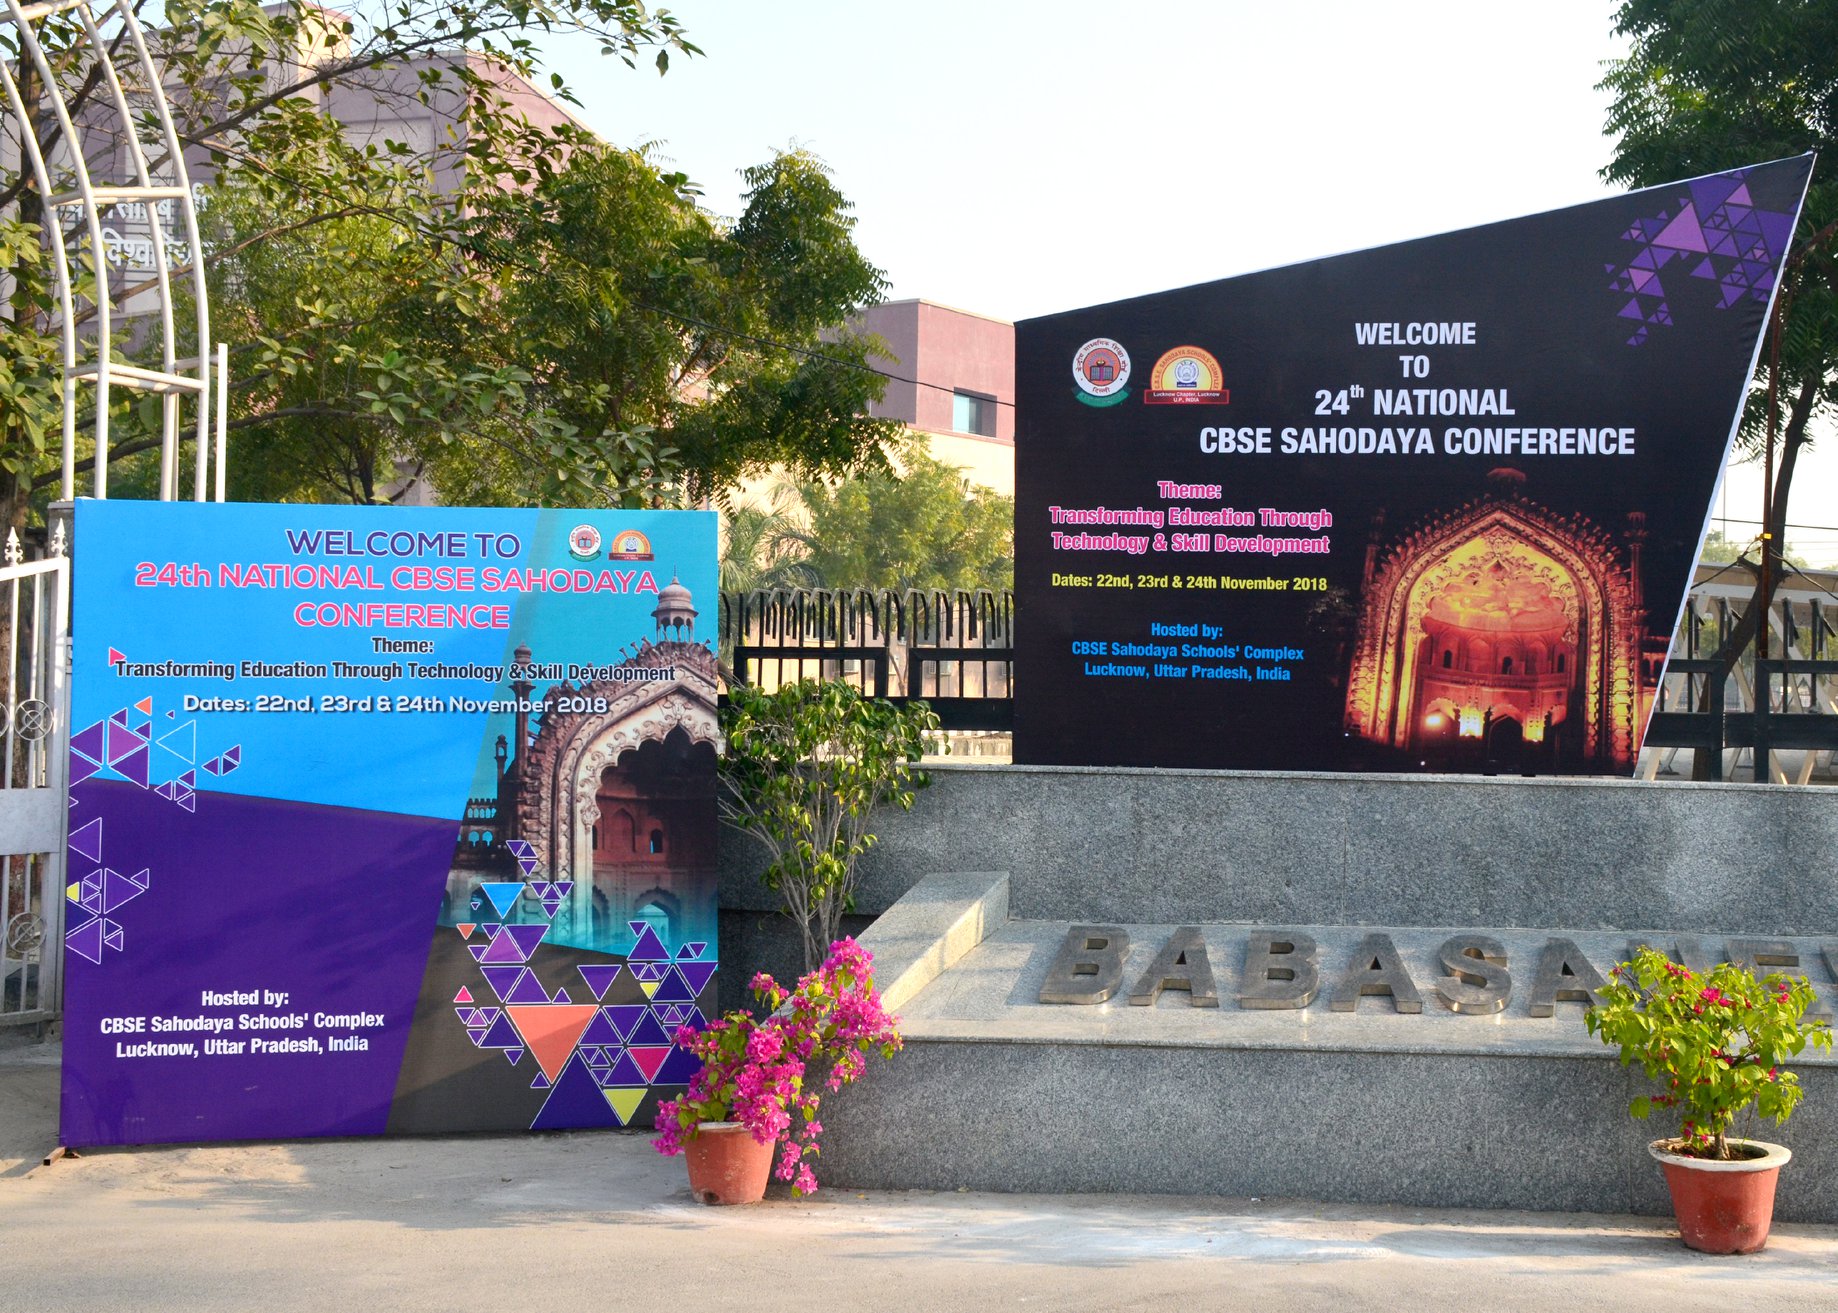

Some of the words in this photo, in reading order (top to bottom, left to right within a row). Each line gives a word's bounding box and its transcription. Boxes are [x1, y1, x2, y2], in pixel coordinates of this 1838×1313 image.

[1355, 322, 1477, 345] WELCOME
[1399, 355, 1430, 378] TO
[1314, 385, 1365, 416] 24th
[1373, 388, 1515, 416] NATIONAL
[1199, 427, 1272, 454] CBSE
[1281, 427, 1435, 455] SAHODAYA
[1444, 427, 1636, 456] CONFERENCE
[1157, 481, 1222, 499] Theme:
[1049, 506, 1164, 528] Transforming
[1169, 508, 1255, 526] Education
[1259, 509, 1333, 530] Through
[286, 529, 467, 557] WELCOME
[474, 533, 521, 559] TO
[1051, 532, 1149, 554] Technology
[1153, 534, 1167, 551] &
[1171, 533, 1210, 552] Skill
[1215, 534, 1330, 556] Development
[135, 562, 211, 588] 24th
[219, 563, 384, 590] NATIONAL
[391, 566, 475, 592] CBSE
[481, 568, 659, 594] SAHODAYA
[1052, 573, 1093, 587] Dates:
[1096, 574, 1133, 590] 22nd,
[1137, 575, 1168, 588] 23rd
[1172, 576, 1183, 589] &
[1186, 576, 1217, 590] 24th
[1220, 576, 1289, 590] November
[1293, 577, 1328, 591] 2018
[294, 602, 510, 629] CONFERENCE
[1151, 622, 1198, 637] Hosted
[1202, 623, 1223, 640] by:
[371, 637, 434, 653] Theme:
[1072, 641, 1107, 656] CBSE
[1111, 642, 1177, 658] Sahodaya
[1181, 643, 1239, 659] Schools'
[1244, 645, 1304, 662] Complex
[115, 660, 235, 680] Transforming
[241, 661, 327, 678] Education
[332, 662, 402, 681] Through
[408, 662, 503, 682] Technology
[509, 664, 523, 680] &
[526, 664, 562, 680] Skill
[568, 664, 675, 684] Development
[1085, 662, 1149, 679] Lucknow,
[1154, 664, 1187, 678] Uttar
[1192, 665, 1252, 682] Pradesh,
[1256, 666, 1291, 681] India
[184, 694, 250, 712] Dates:
[255, 695, 316, 714] 22nd,
[320, 695, 372, 713] 23rd
[376, 697, 391, 713] &
[396, 695, 446, 713] 24th
[450, 696, 553, 713] November
[557, 696, 607, 713] 2018
[202, 990, 259, 1006] Hosted
[264, 989, 289, 1008] by:
[100, 1016, 146, 1034] CBSE
[151, 1015, 233, 1033] Sahodaya
[239, 1013, 308, 1030] Schools'
[314, 1012, 385, 1030] Complex
[116, 1041, 199, 1058] Lucknow,
[204, 1039, 246, 1055] Uttar
[251, 1037, 323, 1054] Pradesh,
[328, 1036, 369, 1052] India
